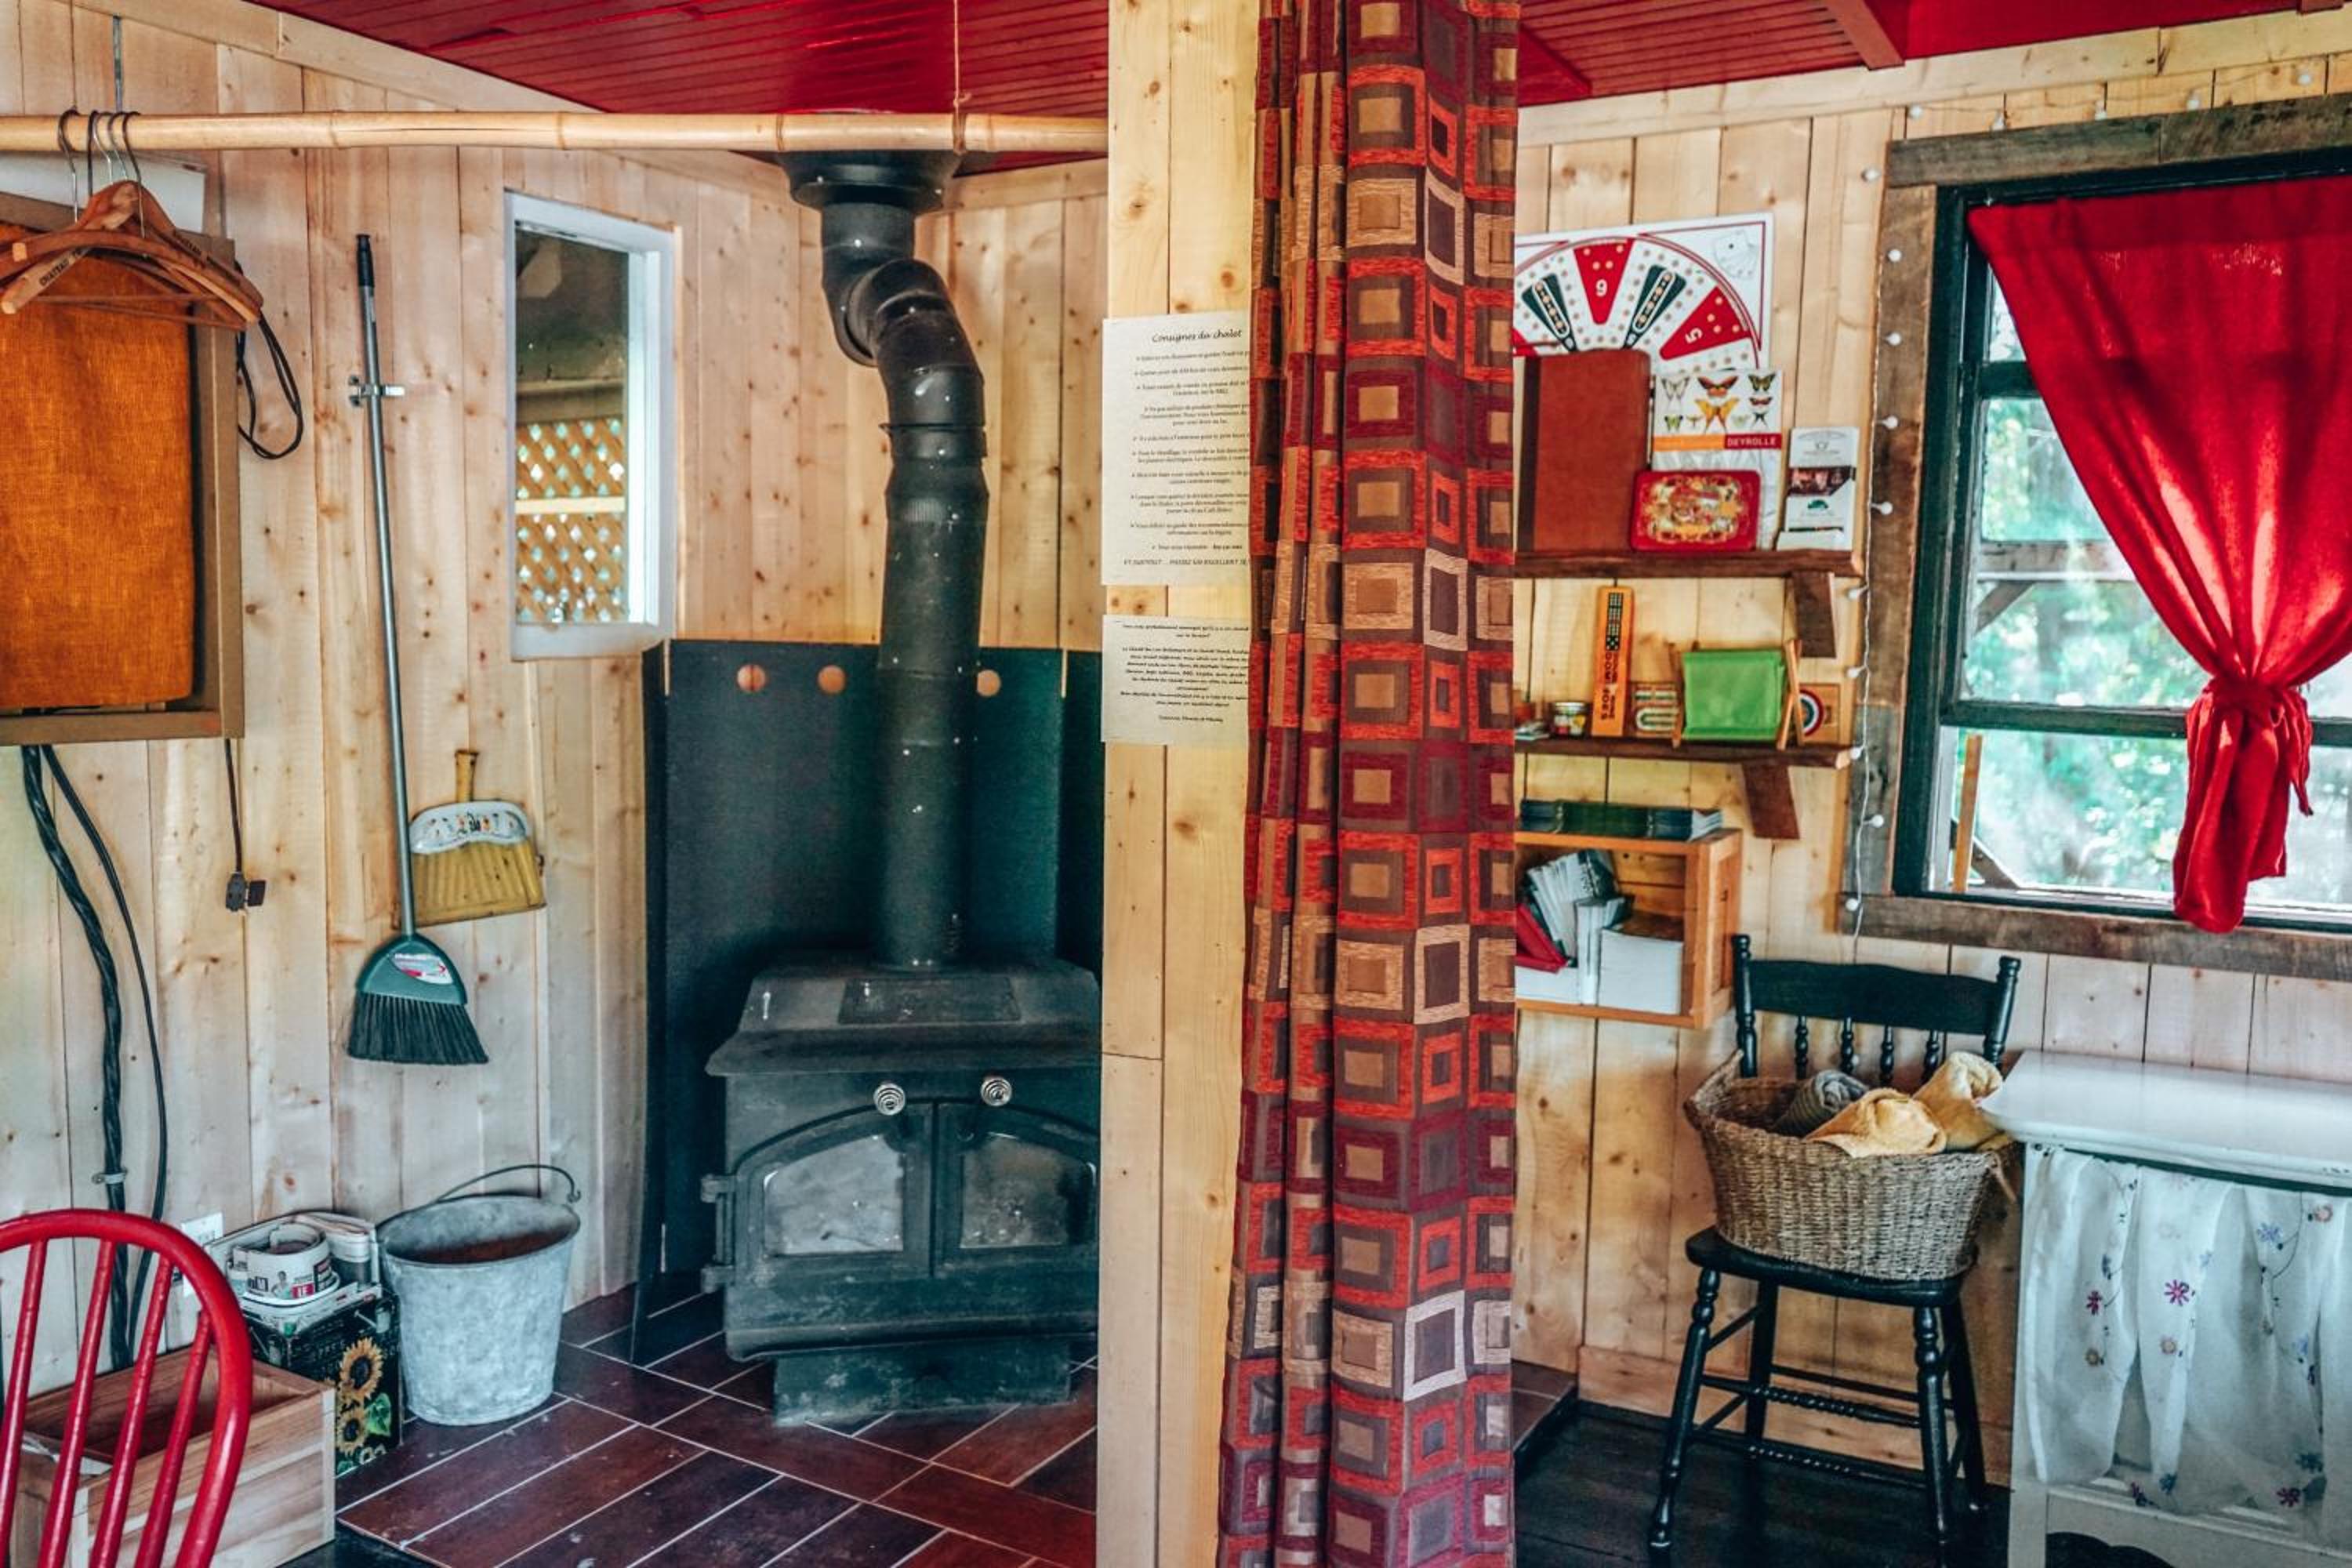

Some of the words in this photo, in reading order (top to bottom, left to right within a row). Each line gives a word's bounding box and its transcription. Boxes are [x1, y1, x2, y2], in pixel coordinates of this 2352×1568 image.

[1595, 278, 1608, 296] 9
[1198, 330, 1211, 339] du
[1213, 328, 1243, 339] chalet
[1685, 327, 1703, 344] 5
[1727, 437, 1776, 447] DEYROLLE
